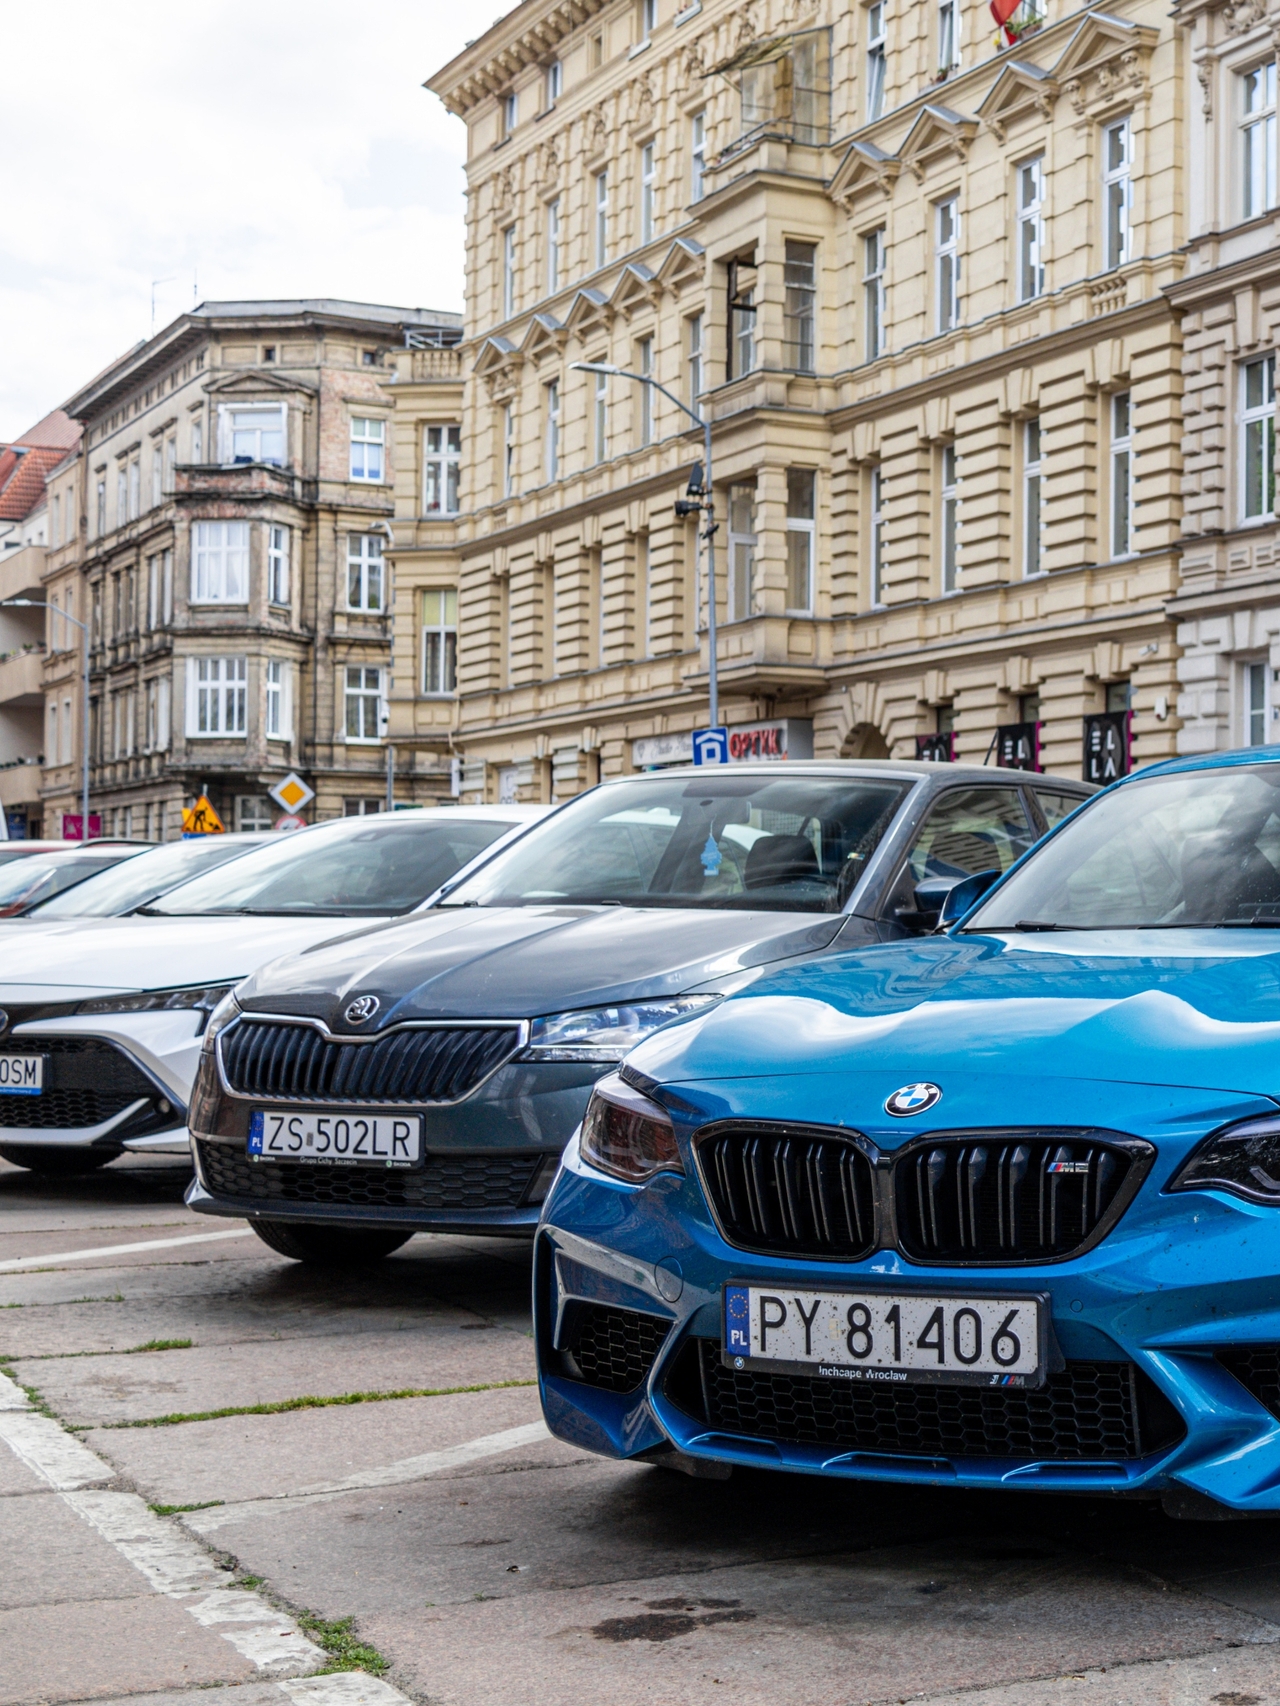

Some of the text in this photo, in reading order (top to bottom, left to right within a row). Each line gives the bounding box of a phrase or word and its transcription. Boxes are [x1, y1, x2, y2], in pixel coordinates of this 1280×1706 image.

[730, 728, 779, 758] OPTYK
[252, 1137, 261, 1147] PL
[268, 1116, 410, 1156] ZS 502LR
[731, 1329, 747, 1347] PL
[759, 1295, 1022, 1367] PY 81406
[819, 1365, 862, 1380] Inchcape
